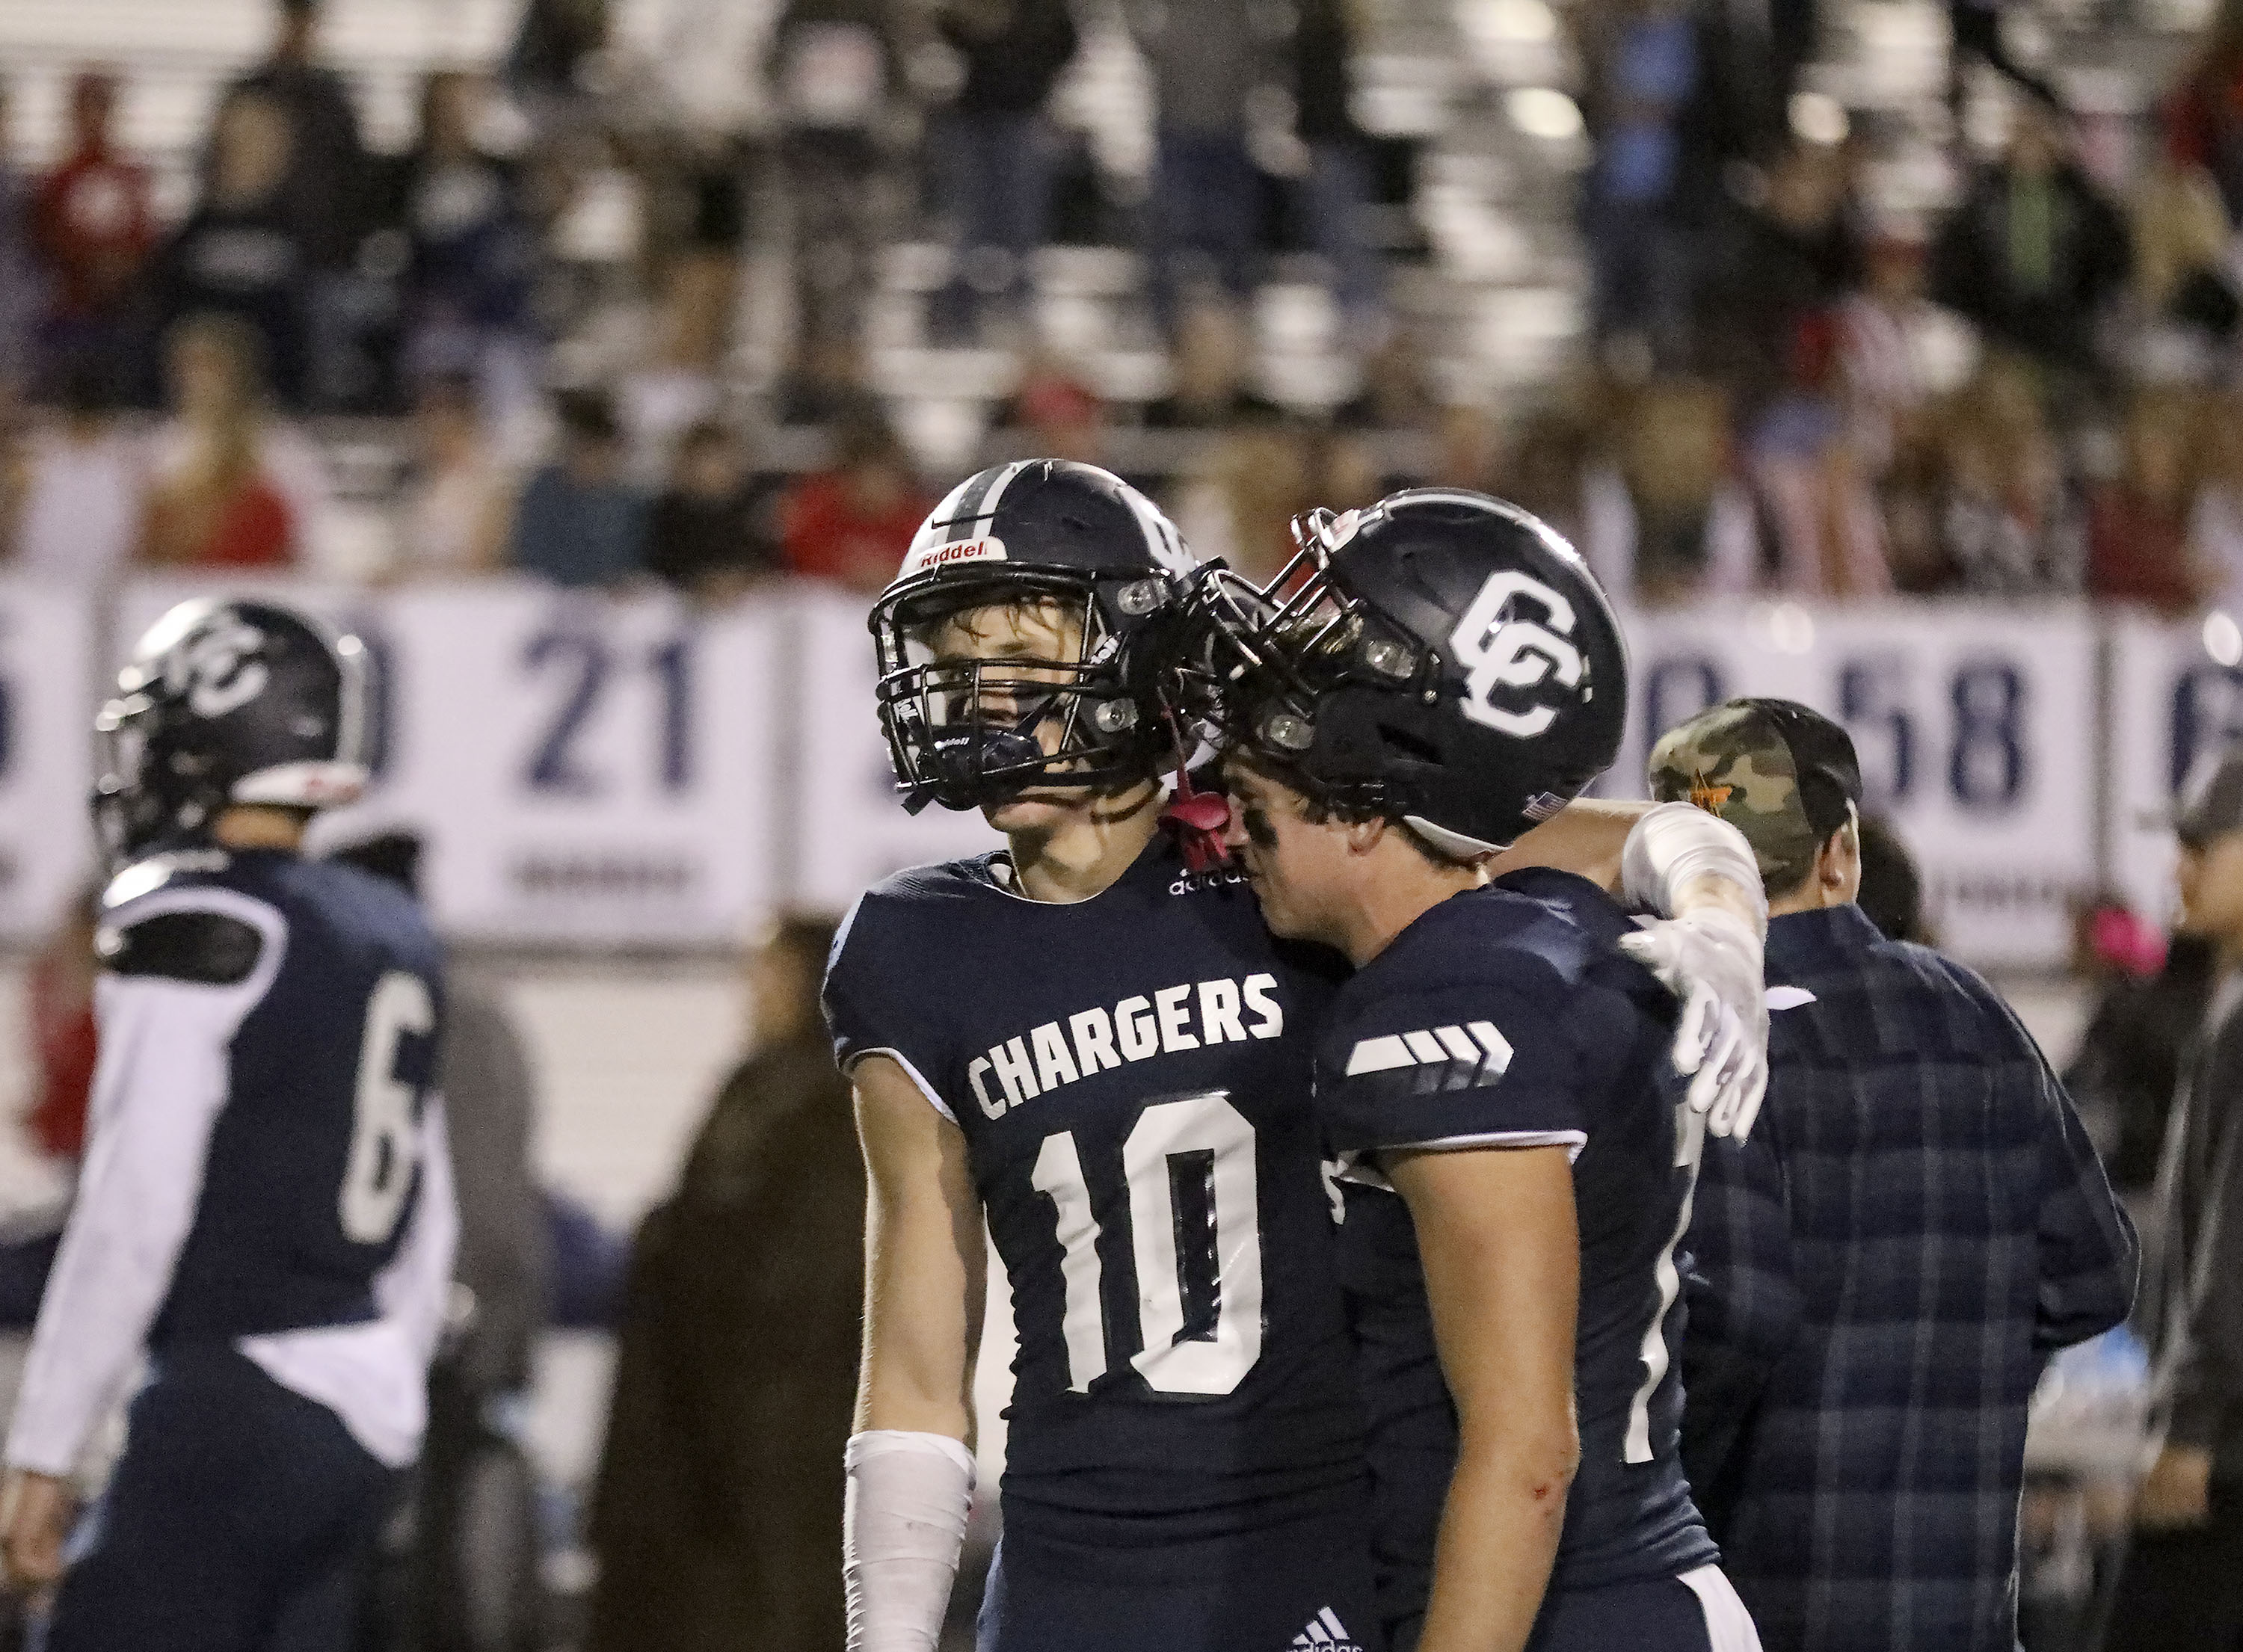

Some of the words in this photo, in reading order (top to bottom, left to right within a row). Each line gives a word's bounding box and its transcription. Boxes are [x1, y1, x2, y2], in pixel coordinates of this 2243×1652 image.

[920, 540, 988, 567] Riddel
[516, 629, 697, 798] 21
[1839, 652, 2028, 810] 58
[337, 972, 436, 1244] 6
[968, 973, 1284, 1121] CHARGERS
[1031, 1094, 1264, 1395] 10
